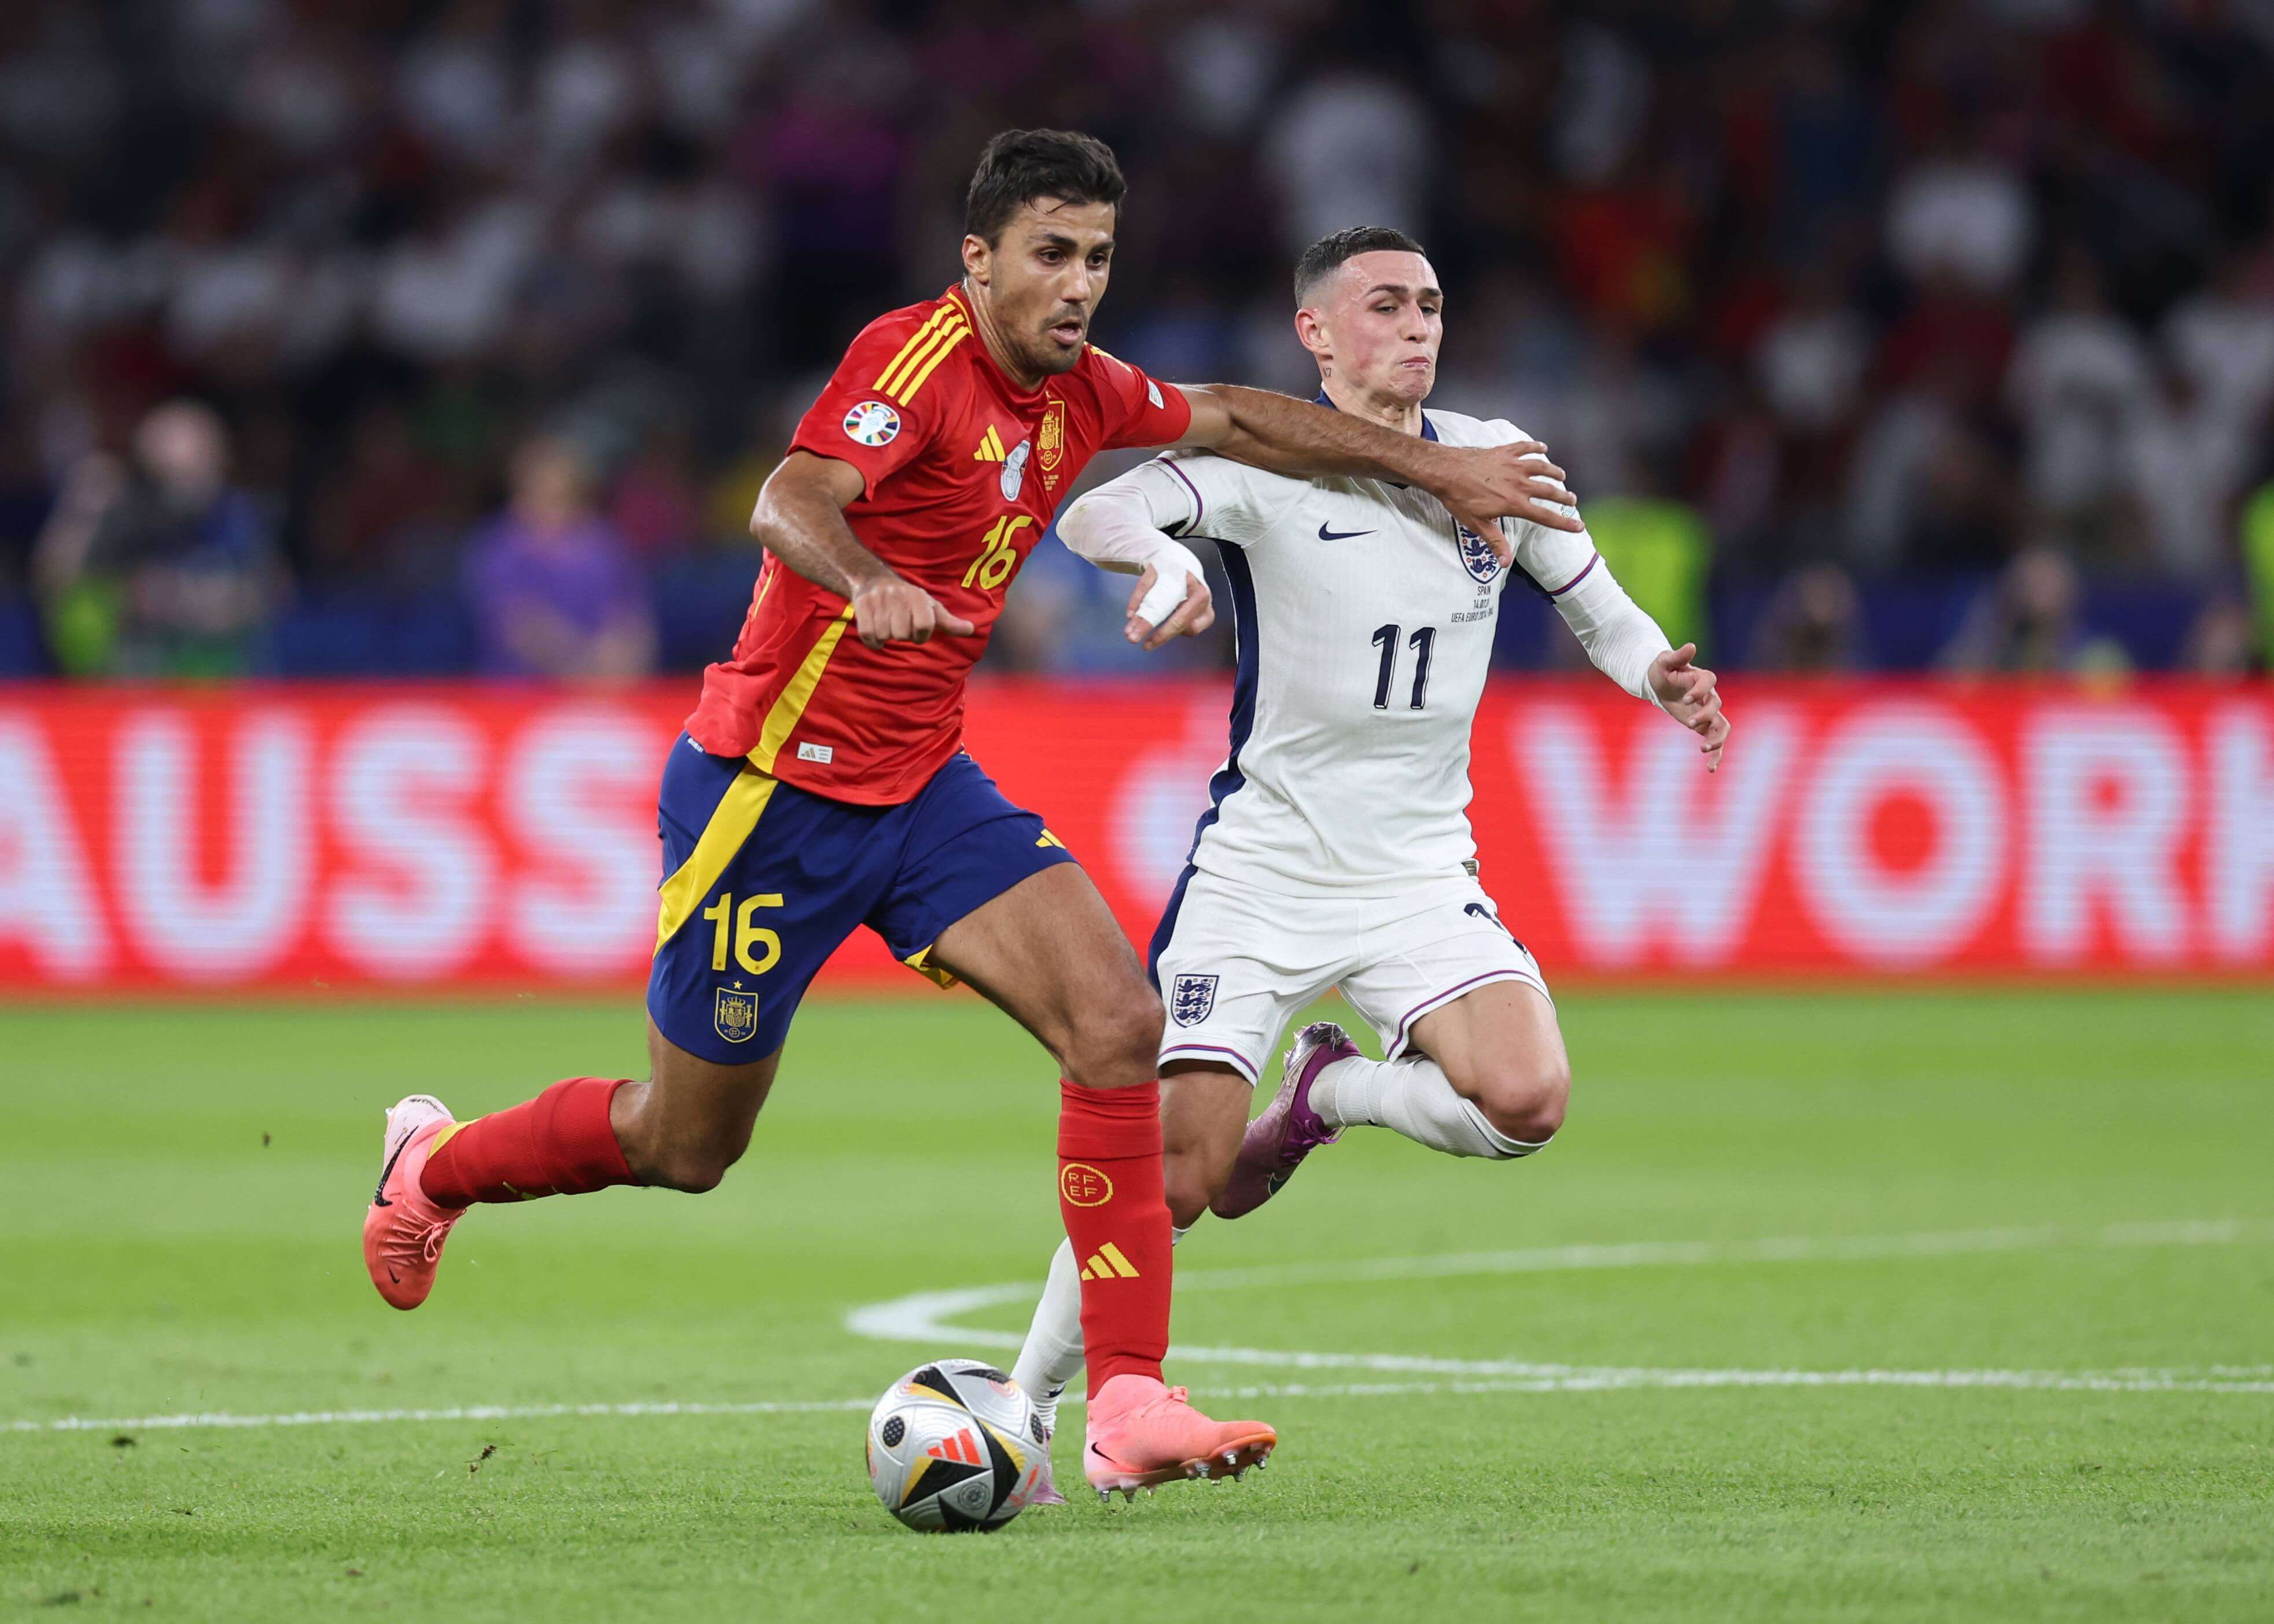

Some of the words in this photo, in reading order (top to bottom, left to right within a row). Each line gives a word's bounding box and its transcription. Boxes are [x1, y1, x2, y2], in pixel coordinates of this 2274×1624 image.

[961, 515, 1033, 590] 16
[1451, 613, 1465, 623] UEFA
[1466, 612, 1479, 623] EURO
[1477, 585, 1491, 596] SPAIN
[1372, 624, 1436, 709] 11
[704, 893, 784, 975] 16
